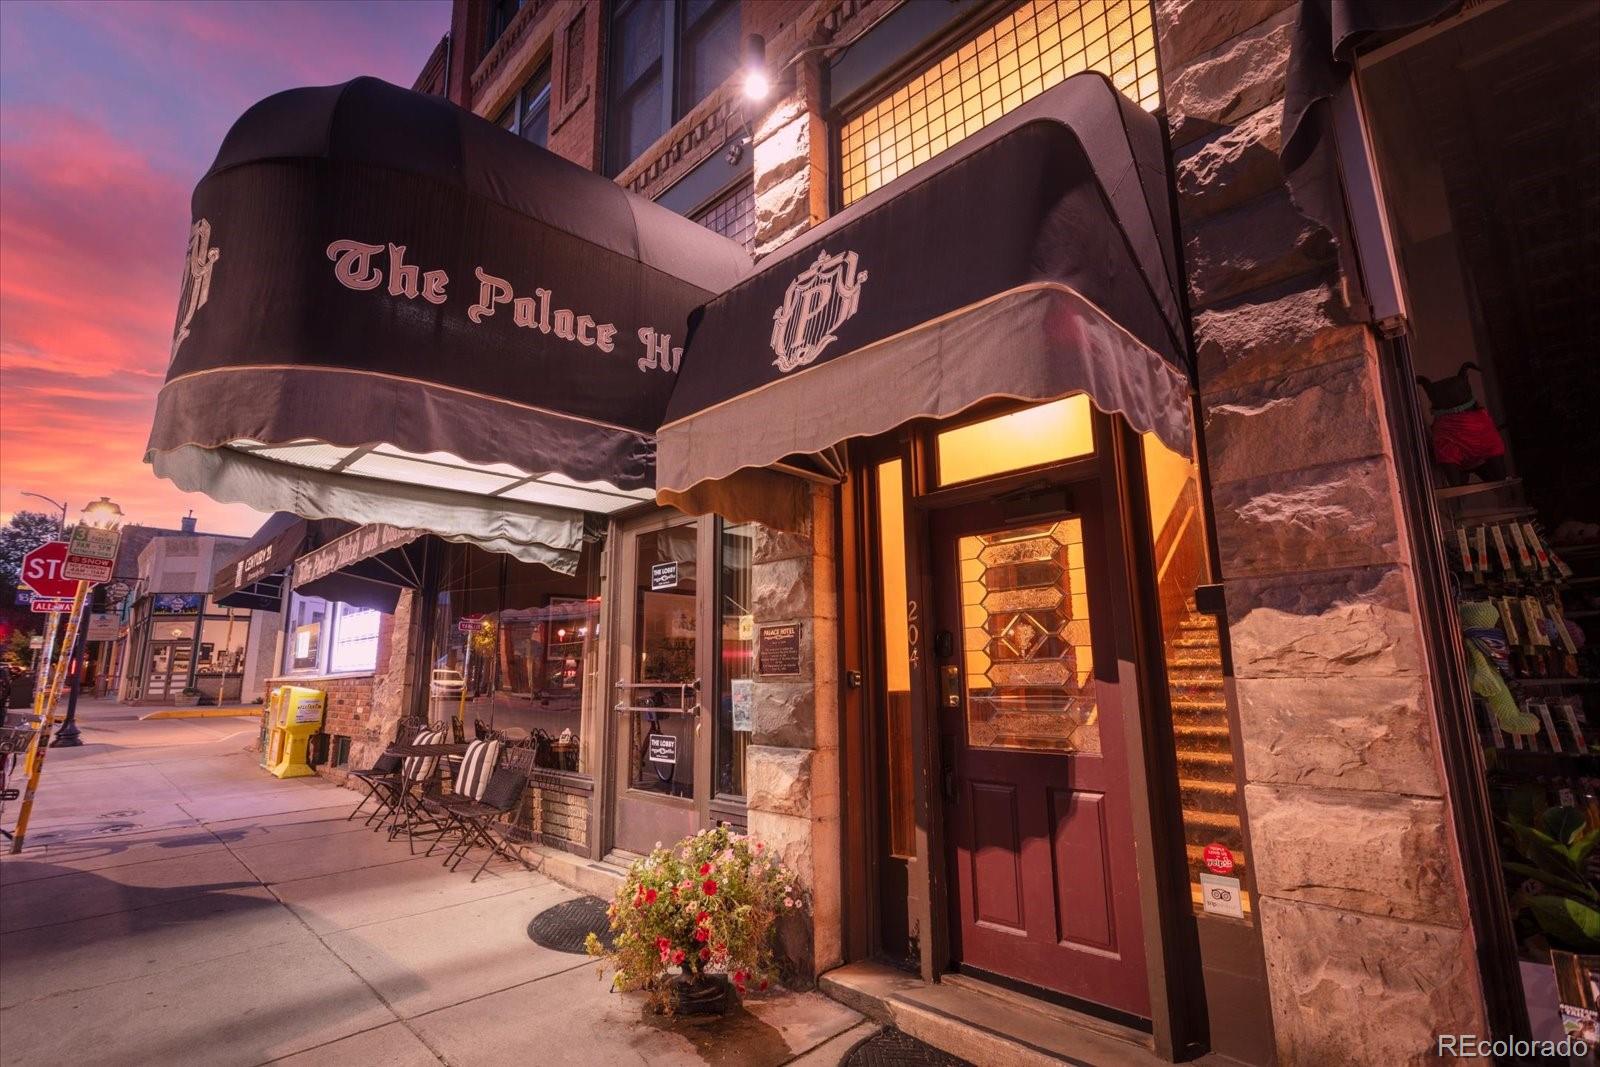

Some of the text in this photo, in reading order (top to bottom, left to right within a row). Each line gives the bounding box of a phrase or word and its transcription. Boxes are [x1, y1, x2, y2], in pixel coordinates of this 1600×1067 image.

[326, 239, 449, 304] The
[468, 266, 618, 353] Palace
[81, 557, 110, 567] SNOW
[27, 558, 62, 579] ST
[661, 566, 676, 575] LOBBY
[35, 602, 52, 611] ALL
[660, 740, 675, 748] LOBBY
